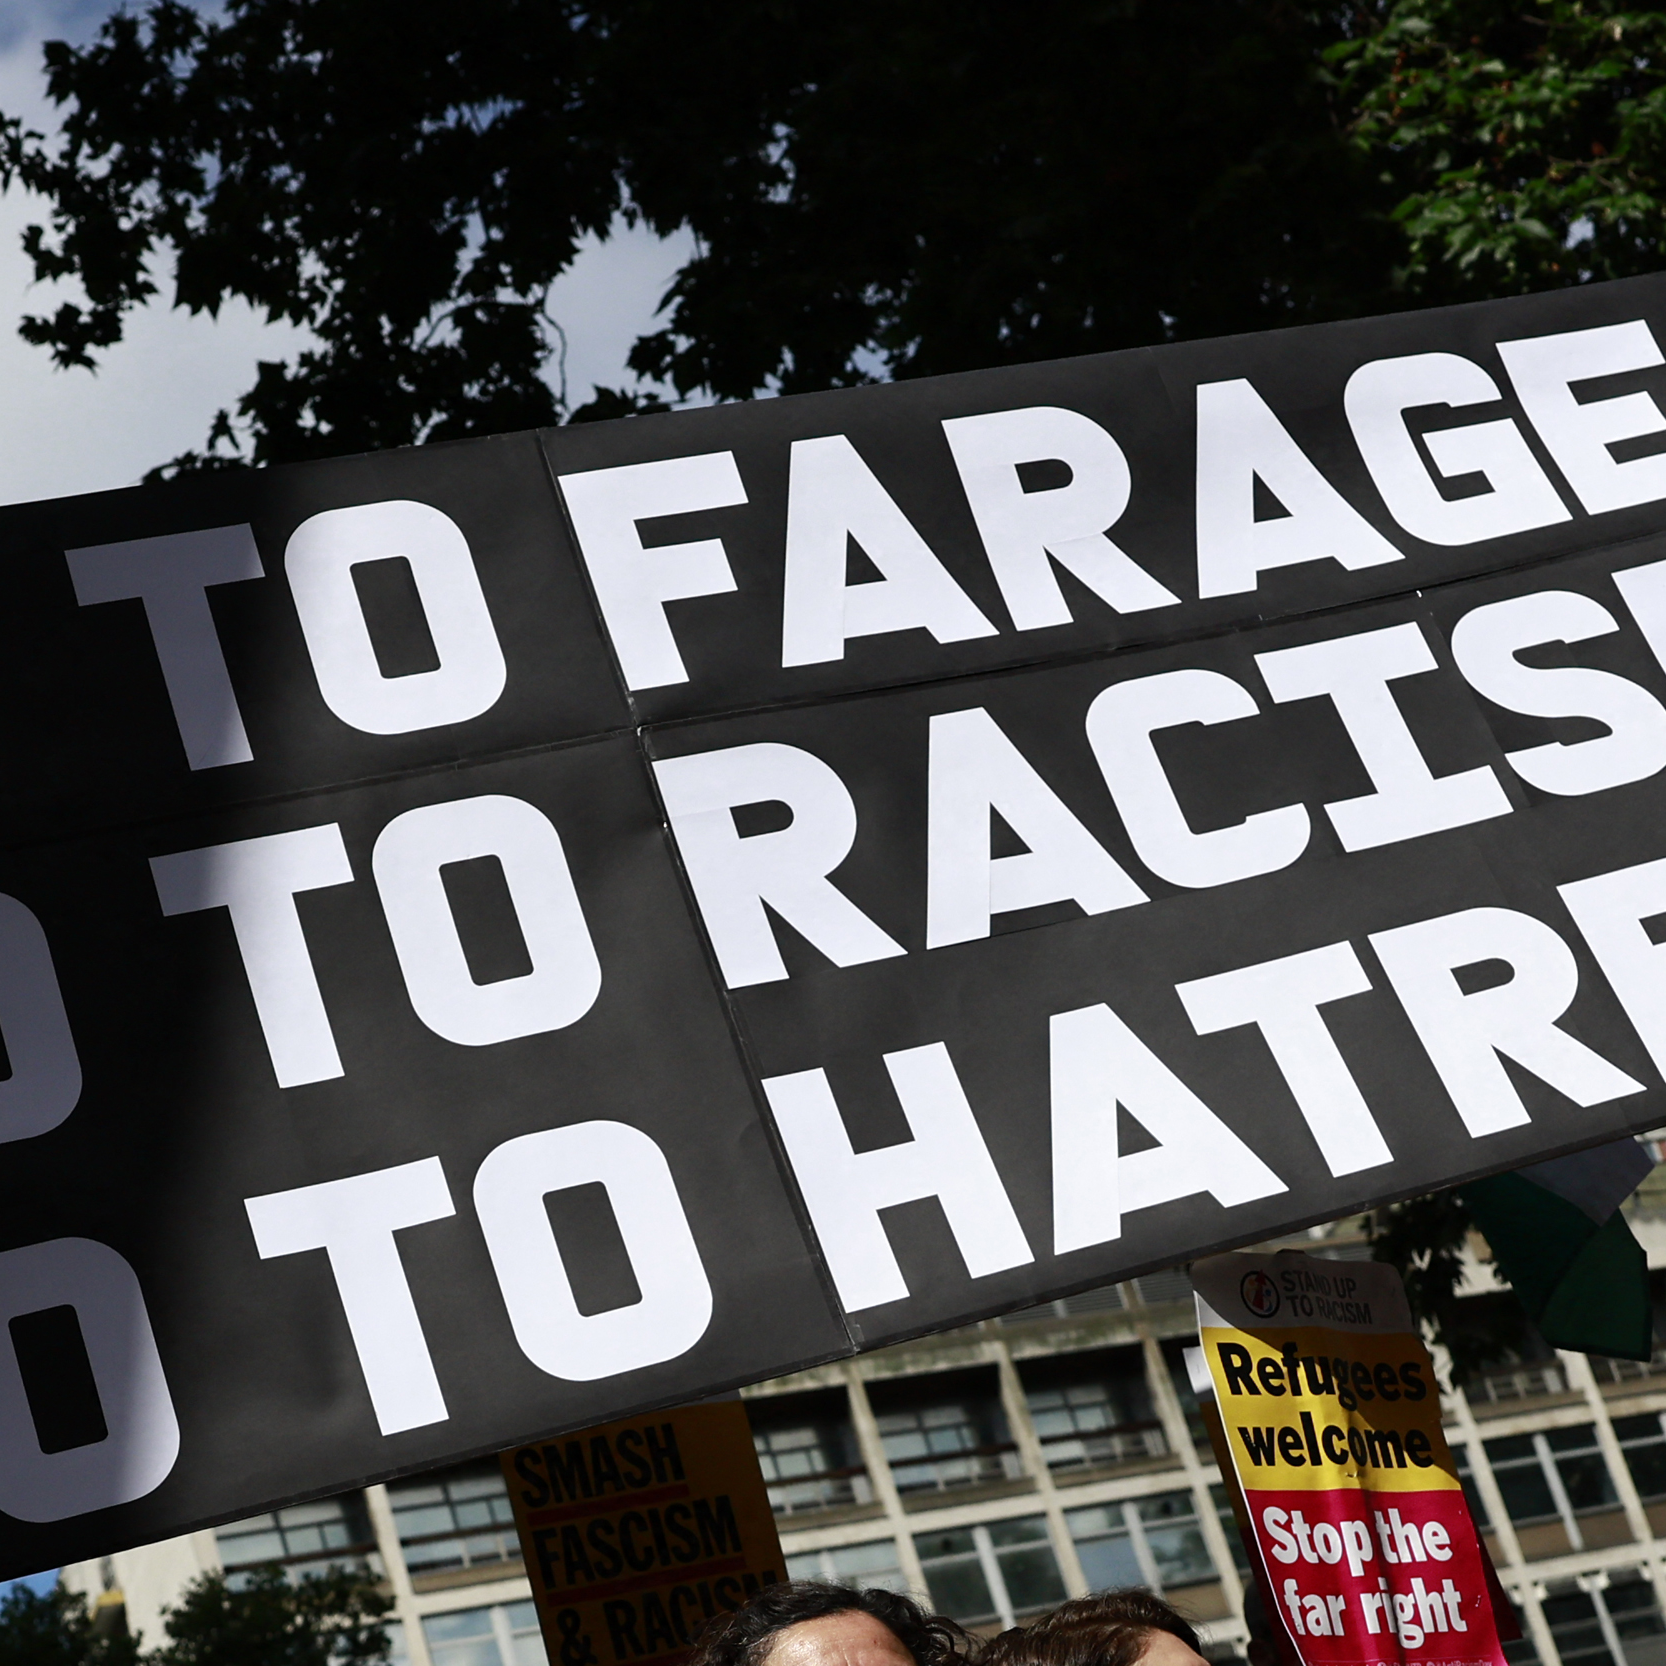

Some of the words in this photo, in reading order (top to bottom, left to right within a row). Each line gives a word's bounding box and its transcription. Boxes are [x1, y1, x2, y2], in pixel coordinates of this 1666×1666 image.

[64, 499, 507, 771] TO
[148, 794, 602, 1089] TO
[243, 1119, 714, 1436] TO
[1280, 1269, 1332, 1296] STAND
[1333, 1276, 1357, 1299] UP
[1285, 1294, 1314, 1318] TO
[1315, 1296, 1374, 1325] RACISM
[1216, 1341, 1428, 1412] Refugees
[513, 1423, 686, 1508] SMASH
[1238, 1411, 1435, 1469] welcome
[531, 1494, 742, 1589] FASCISM
[1263, 1505, 1375, 1578] Stop
[1376, 1507, 1454, 1564] the
[1284, 1578, 1347, 1637] far
[1361, 1577, 1468, 1650] right
